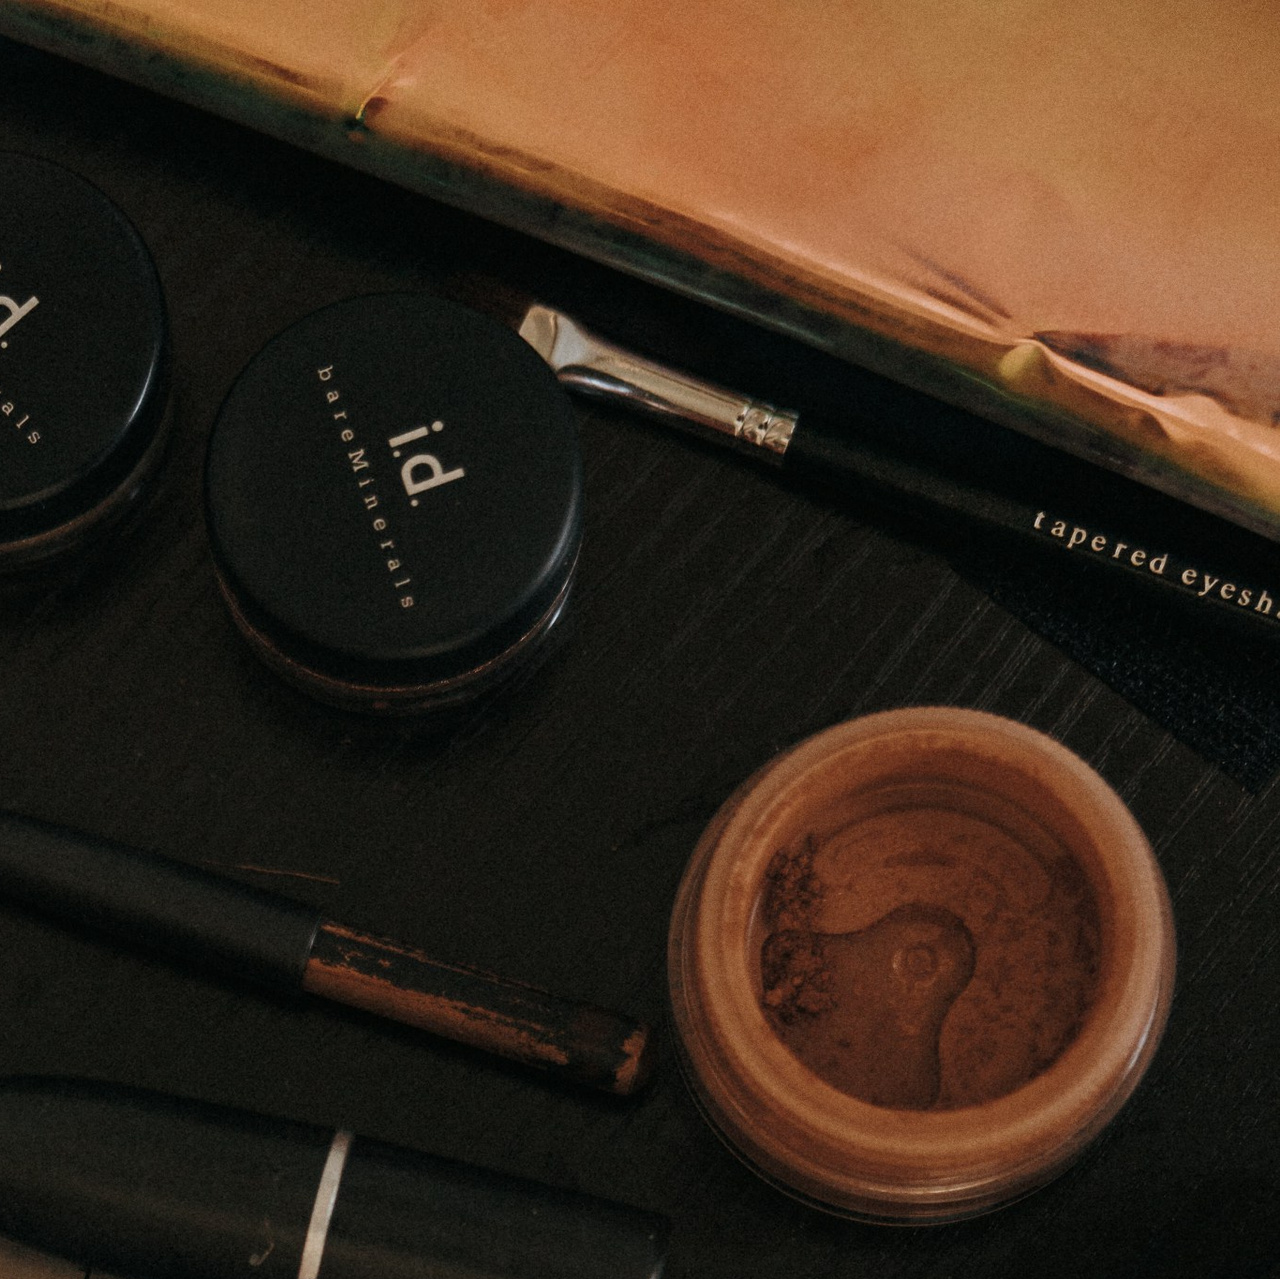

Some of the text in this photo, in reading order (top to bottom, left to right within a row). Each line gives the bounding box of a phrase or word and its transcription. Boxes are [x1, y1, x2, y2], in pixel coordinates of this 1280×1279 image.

[317, 365, 414, 608] bareMinerals
[1033, 511, 1280, 619] tapered eyesh
